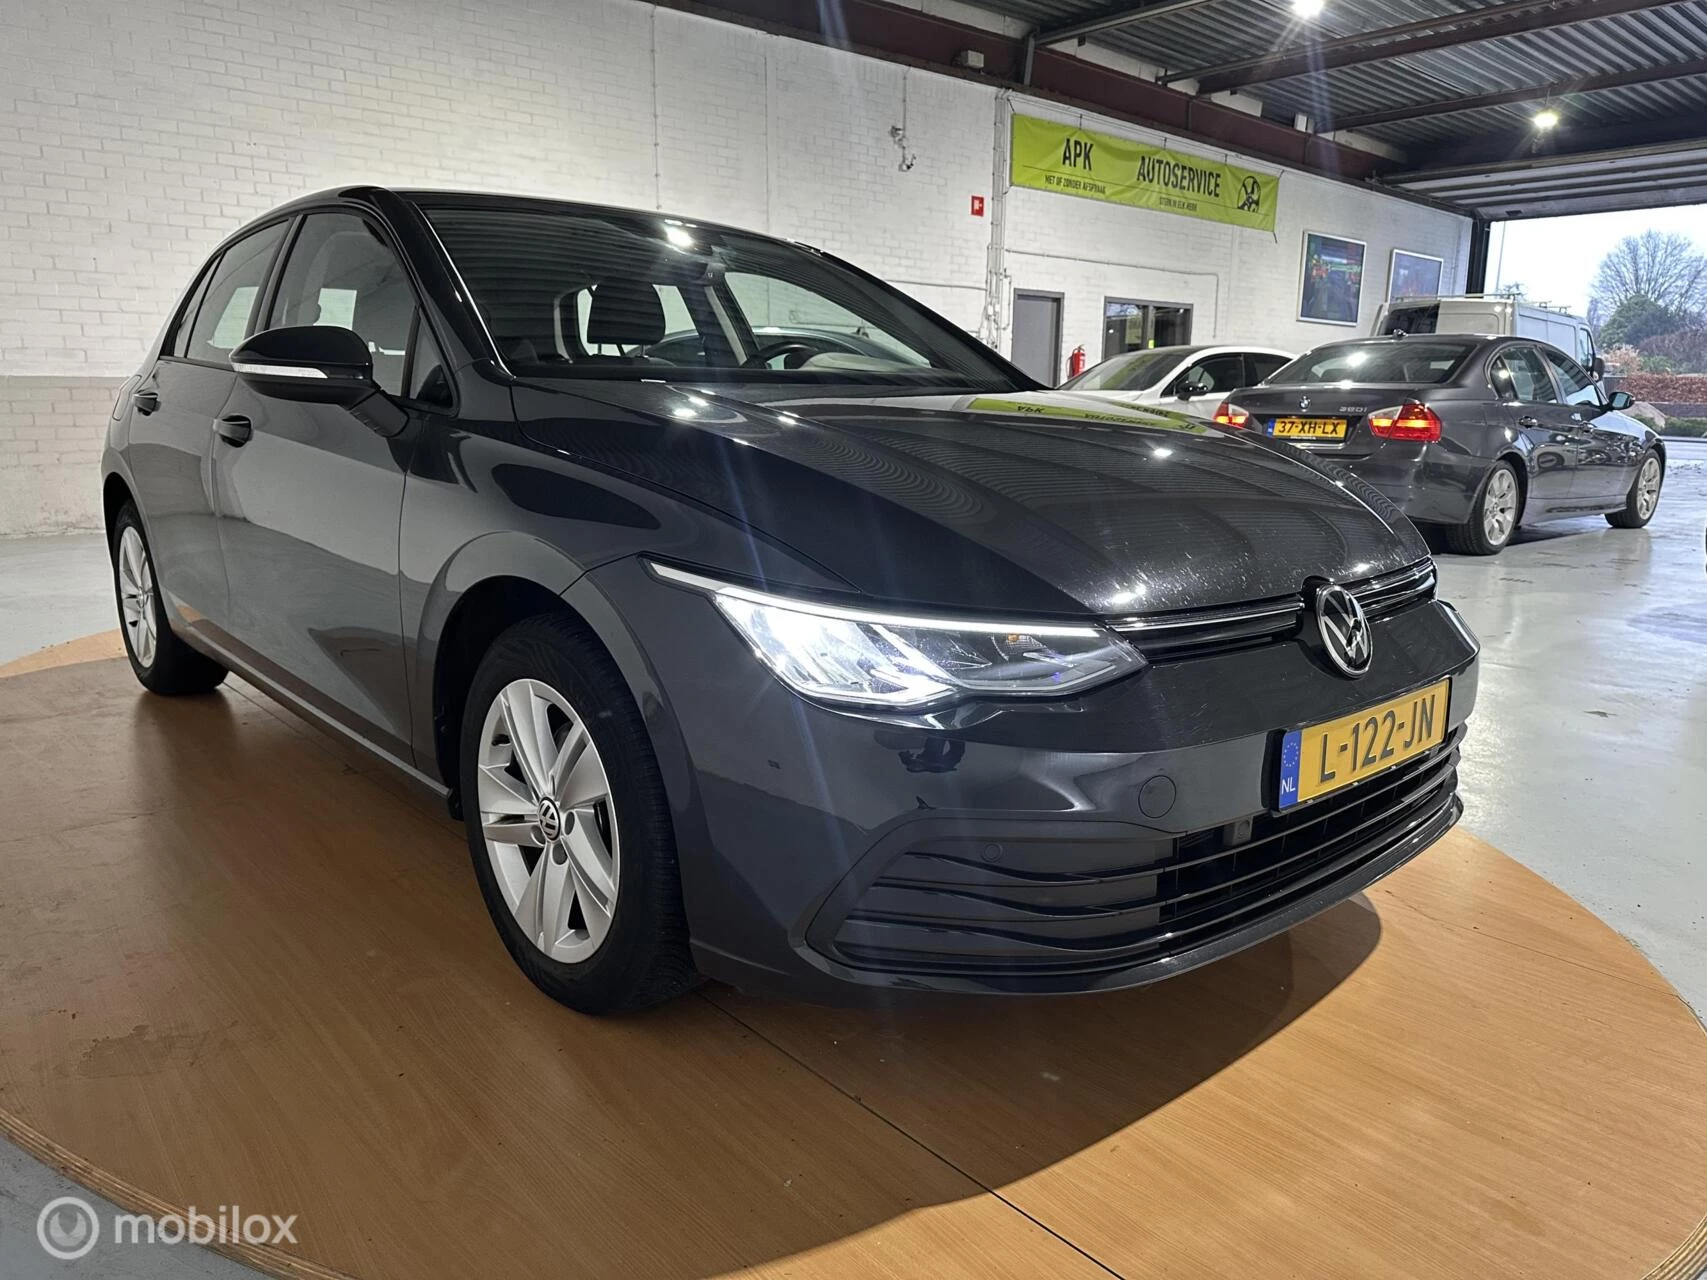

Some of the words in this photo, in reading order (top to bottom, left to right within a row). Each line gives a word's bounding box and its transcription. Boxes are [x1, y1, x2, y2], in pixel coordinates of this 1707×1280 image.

[1062, 138, 1094, 171] APK
[1136, 155, 1222, 198] AUTOSERVICE
[1278, 420, 1341, 435] 37-XH-LX
[1319, 694, 1436, 784] L-122-JN
[1281, 777, 1297, 796] NL
